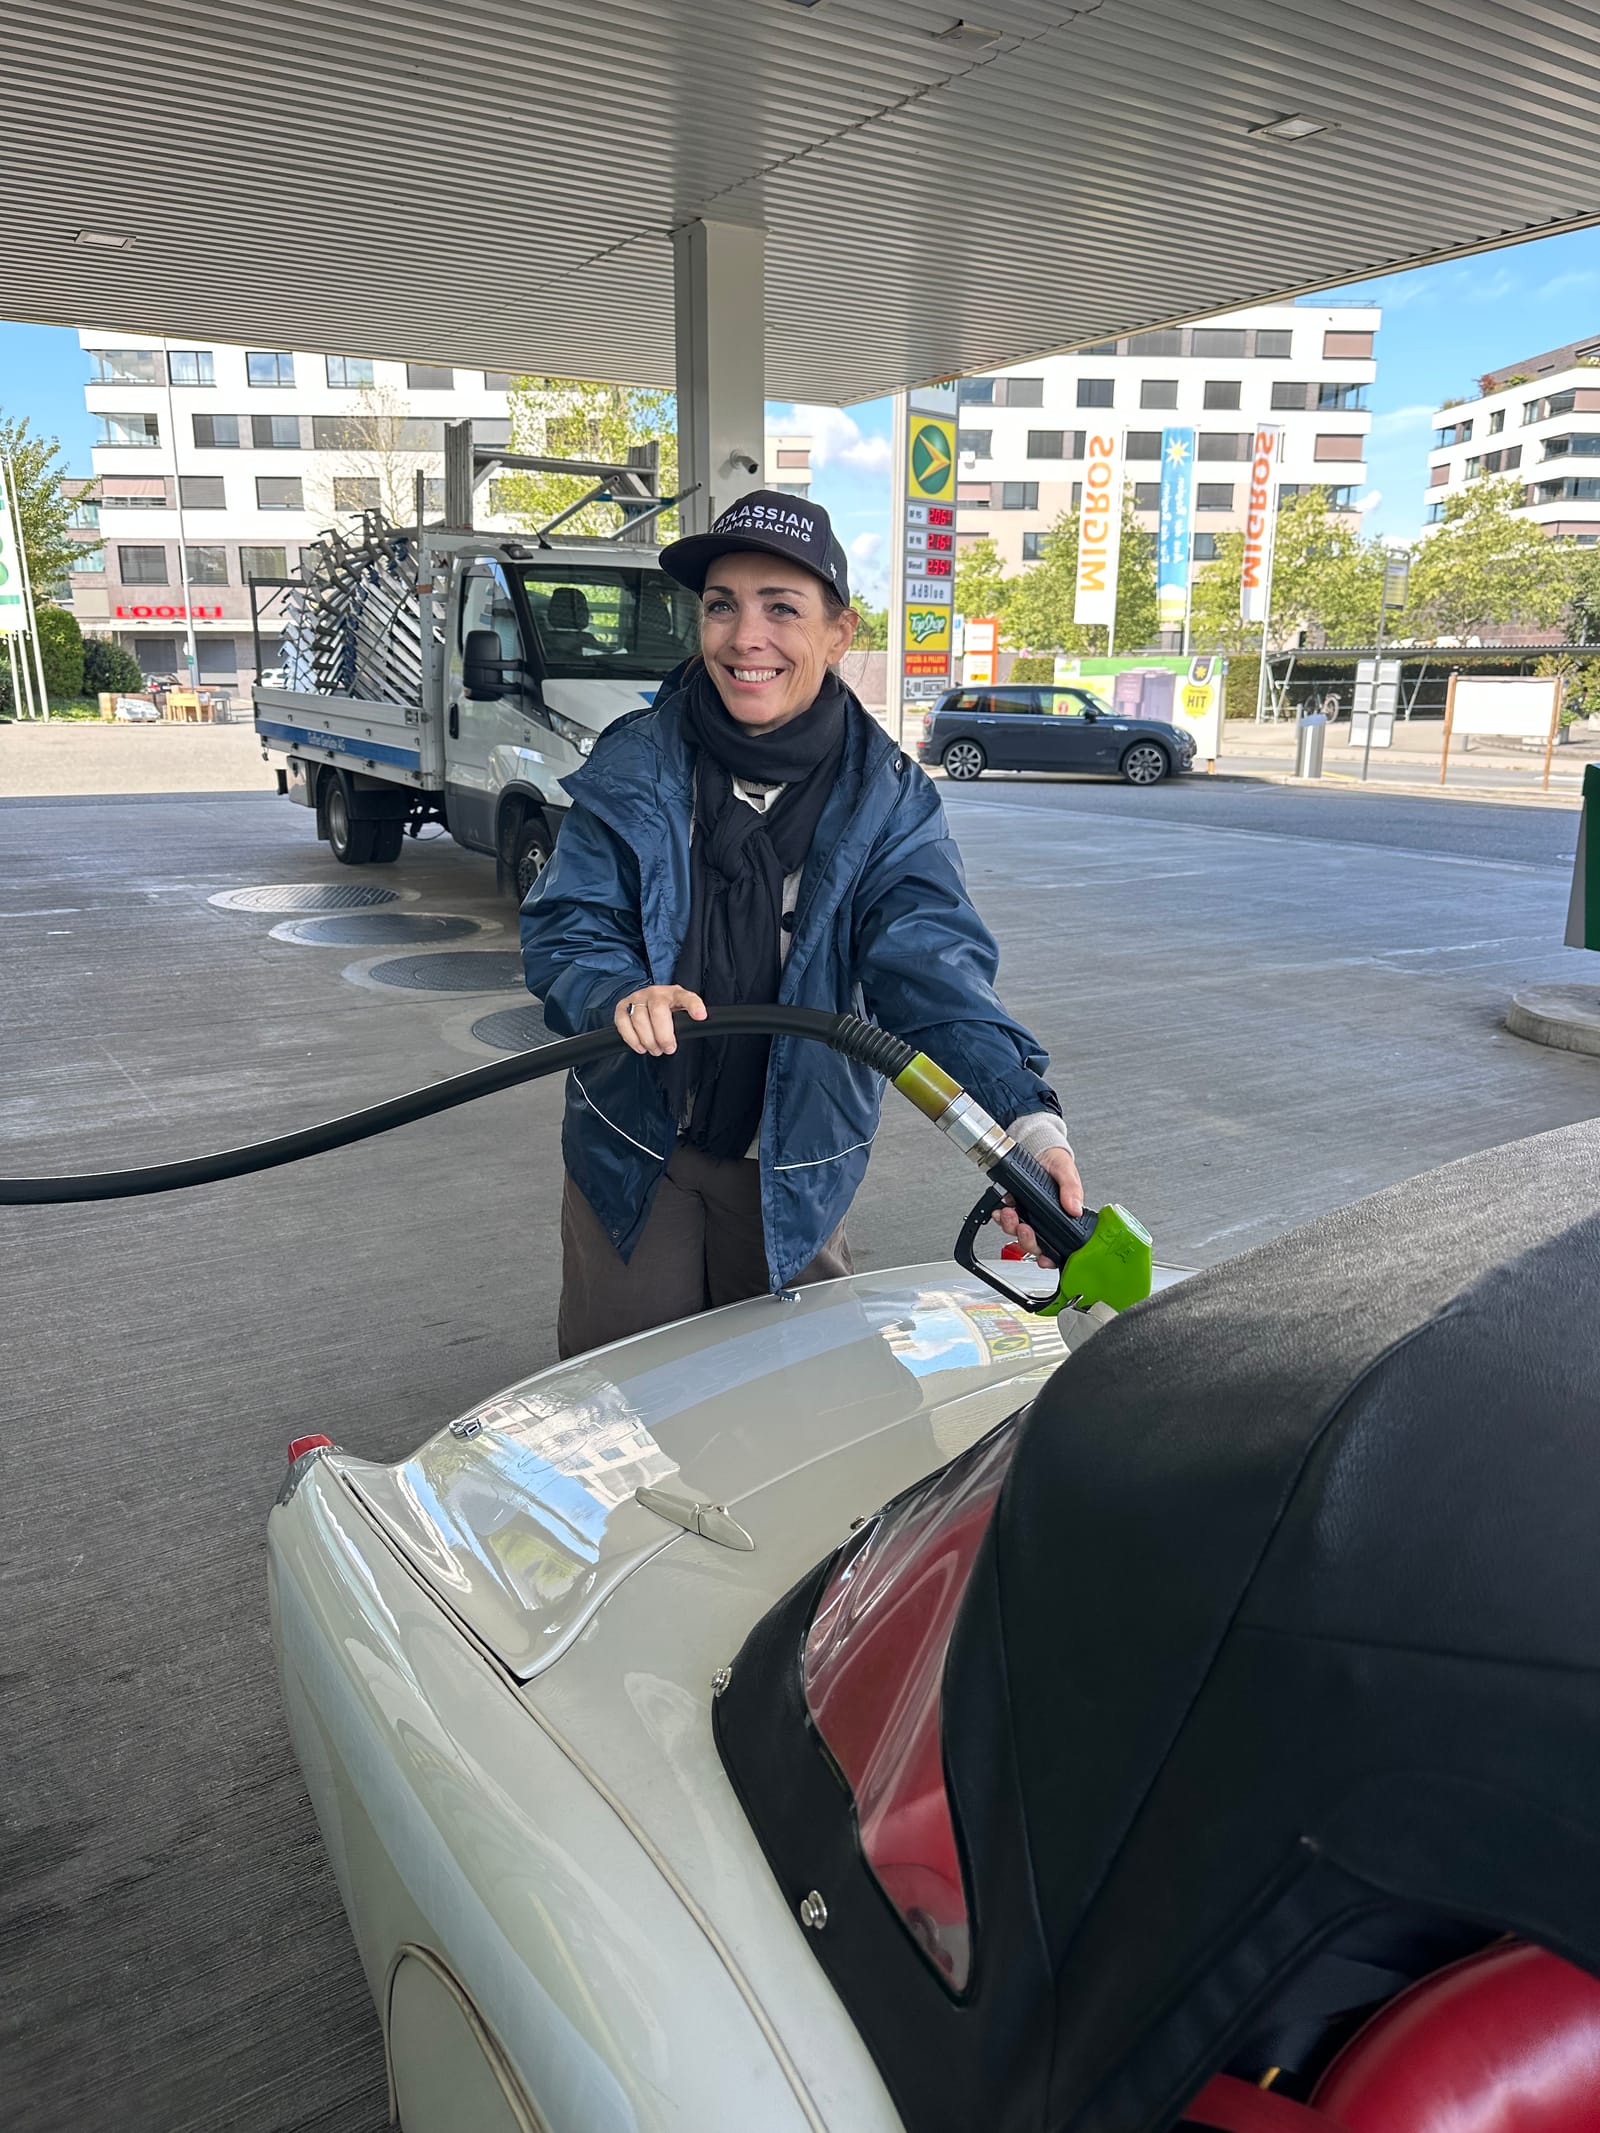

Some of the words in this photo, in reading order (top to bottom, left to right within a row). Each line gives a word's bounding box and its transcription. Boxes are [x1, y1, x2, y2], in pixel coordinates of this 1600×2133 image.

[715, 504, 814, 532] ATLASSIAN
[755, 520, 811, 542] RACING
[911, 584, 944, 599] AdBlue
[910, 613, 945, 638] TopShop
[1187, 695, 1207, 708] HIT
